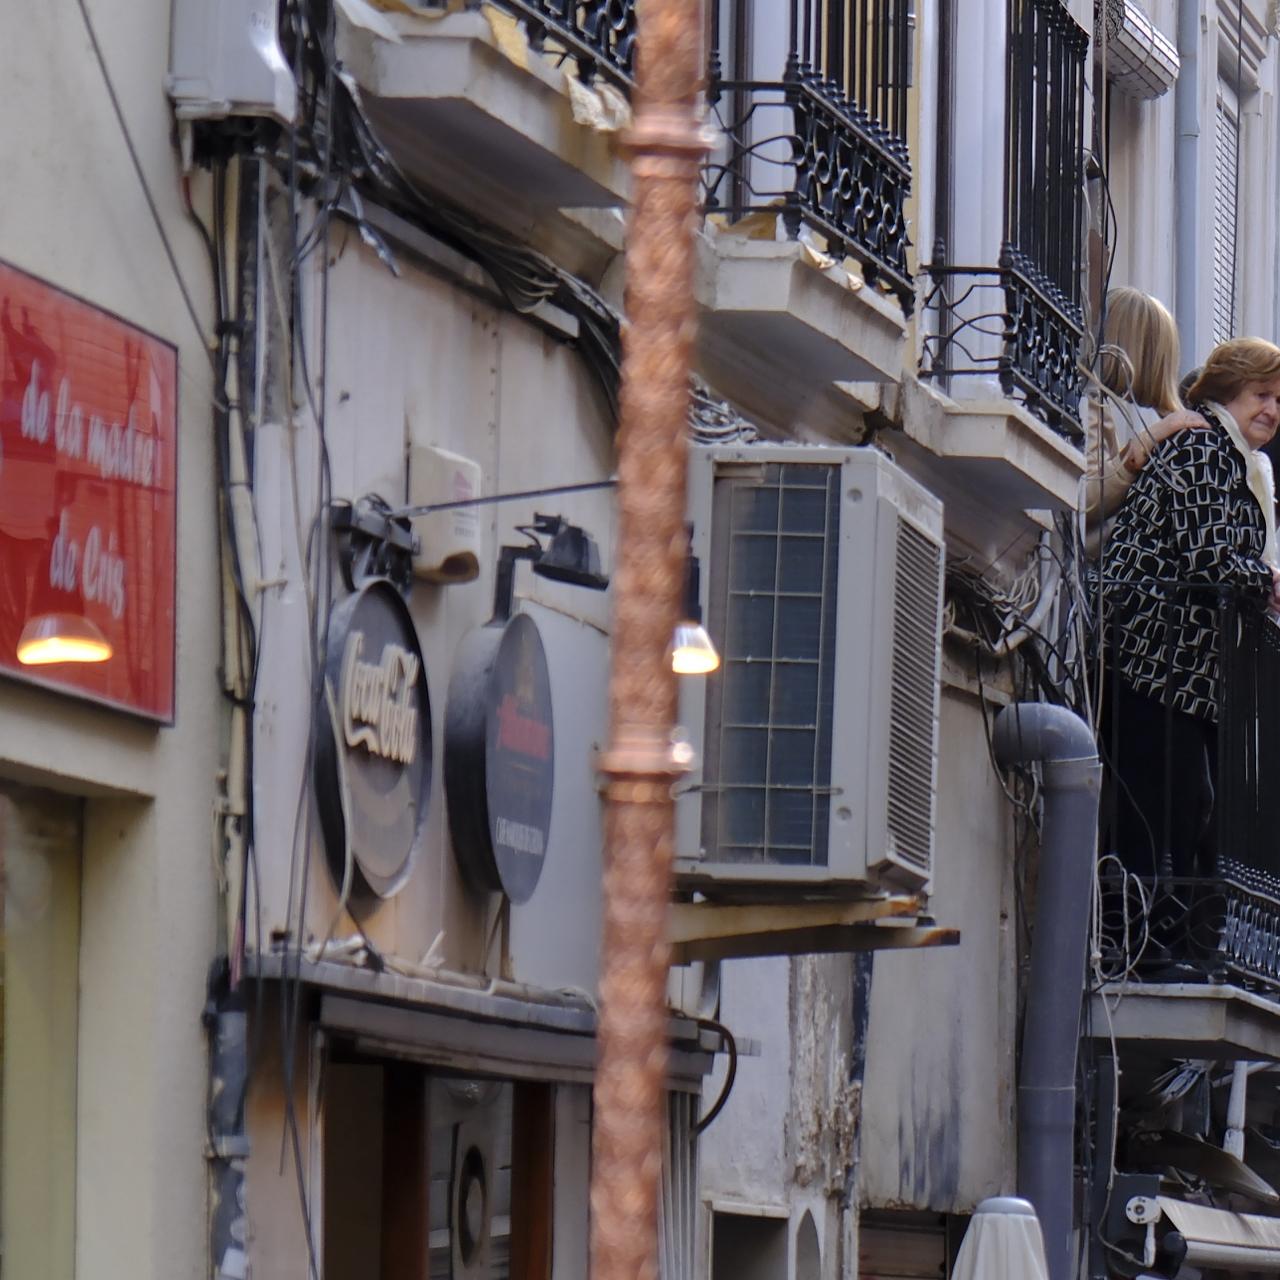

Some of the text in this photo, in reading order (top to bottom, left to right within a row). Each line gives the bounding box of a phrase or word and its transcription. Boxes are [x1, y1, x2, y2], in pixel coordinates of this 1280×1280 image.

[21, 358, 155, 487] de la madre
[50, 506, 126, 620] de Cris
